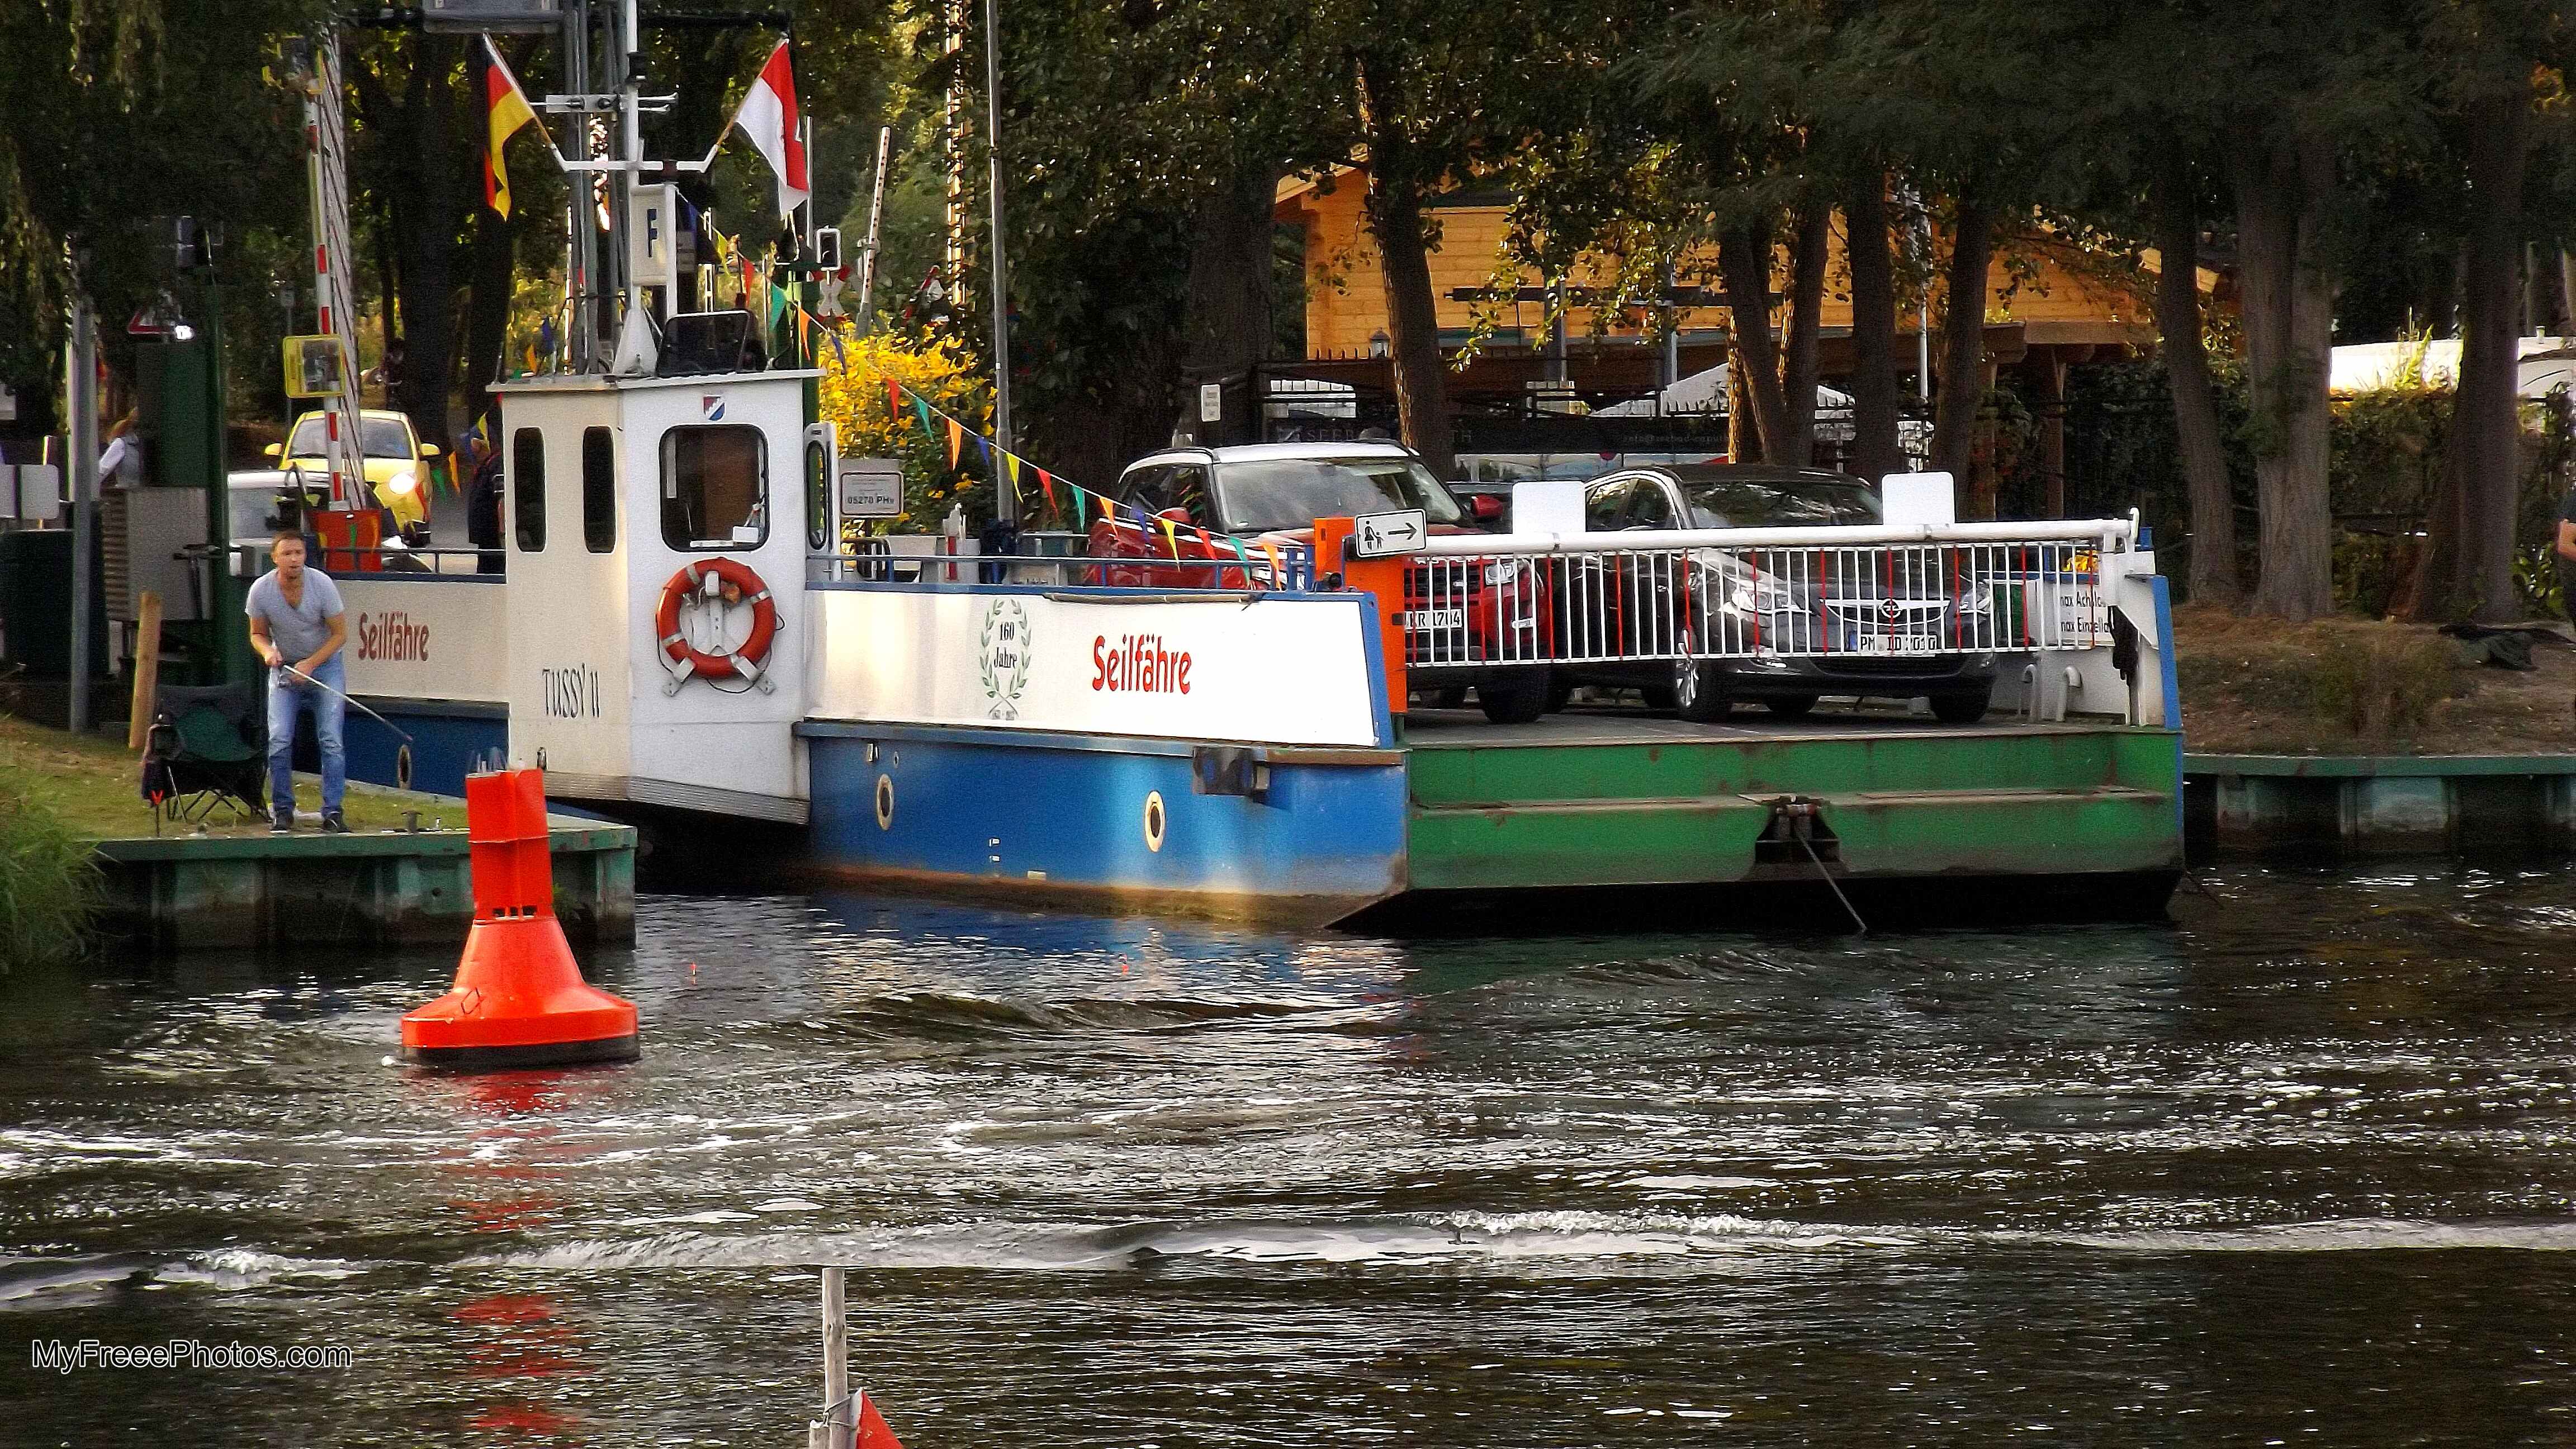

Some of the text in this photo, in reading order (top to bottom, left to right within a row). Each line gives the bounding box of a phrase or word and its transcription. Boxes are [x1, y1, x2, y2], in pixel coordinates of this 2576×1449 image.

[647, 209, 658, 258] F
[358, 610, 429, 662] Seilfähre
[1000, 621, 1015, 641] 160
[993, 646, 1017, 669] Jahre
[1092, 632, 1192, 695] Seilfähre
